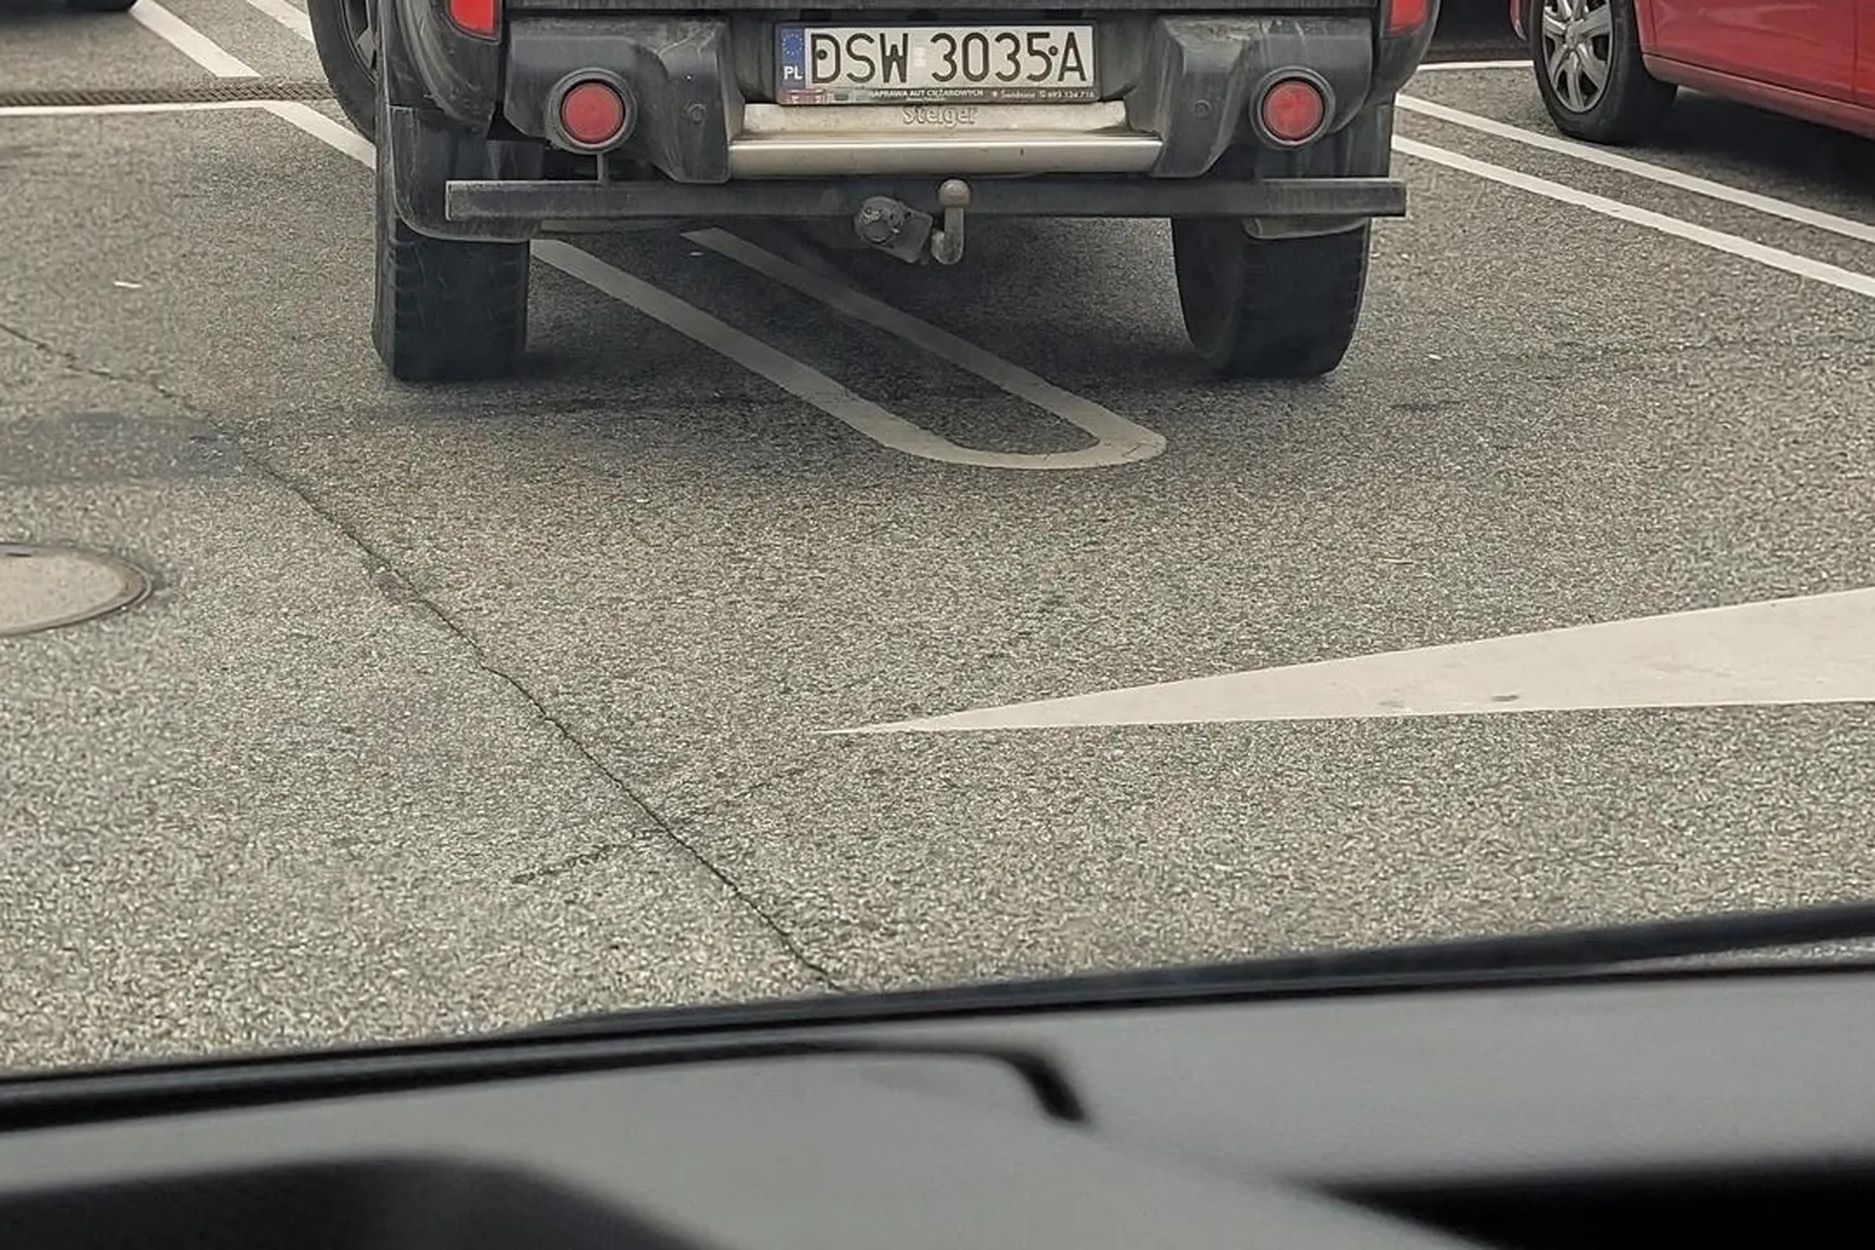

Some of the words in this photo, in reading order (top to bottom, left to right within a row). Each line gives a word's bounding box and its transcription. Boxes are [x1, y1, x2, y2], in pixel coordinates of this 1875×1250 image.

[811, 33, 907, 84] DSW
[930, 32, 1087, 83] 3035A
[784, 66, 803, 79] PL
[903, 106, 976, 127] Steiger
